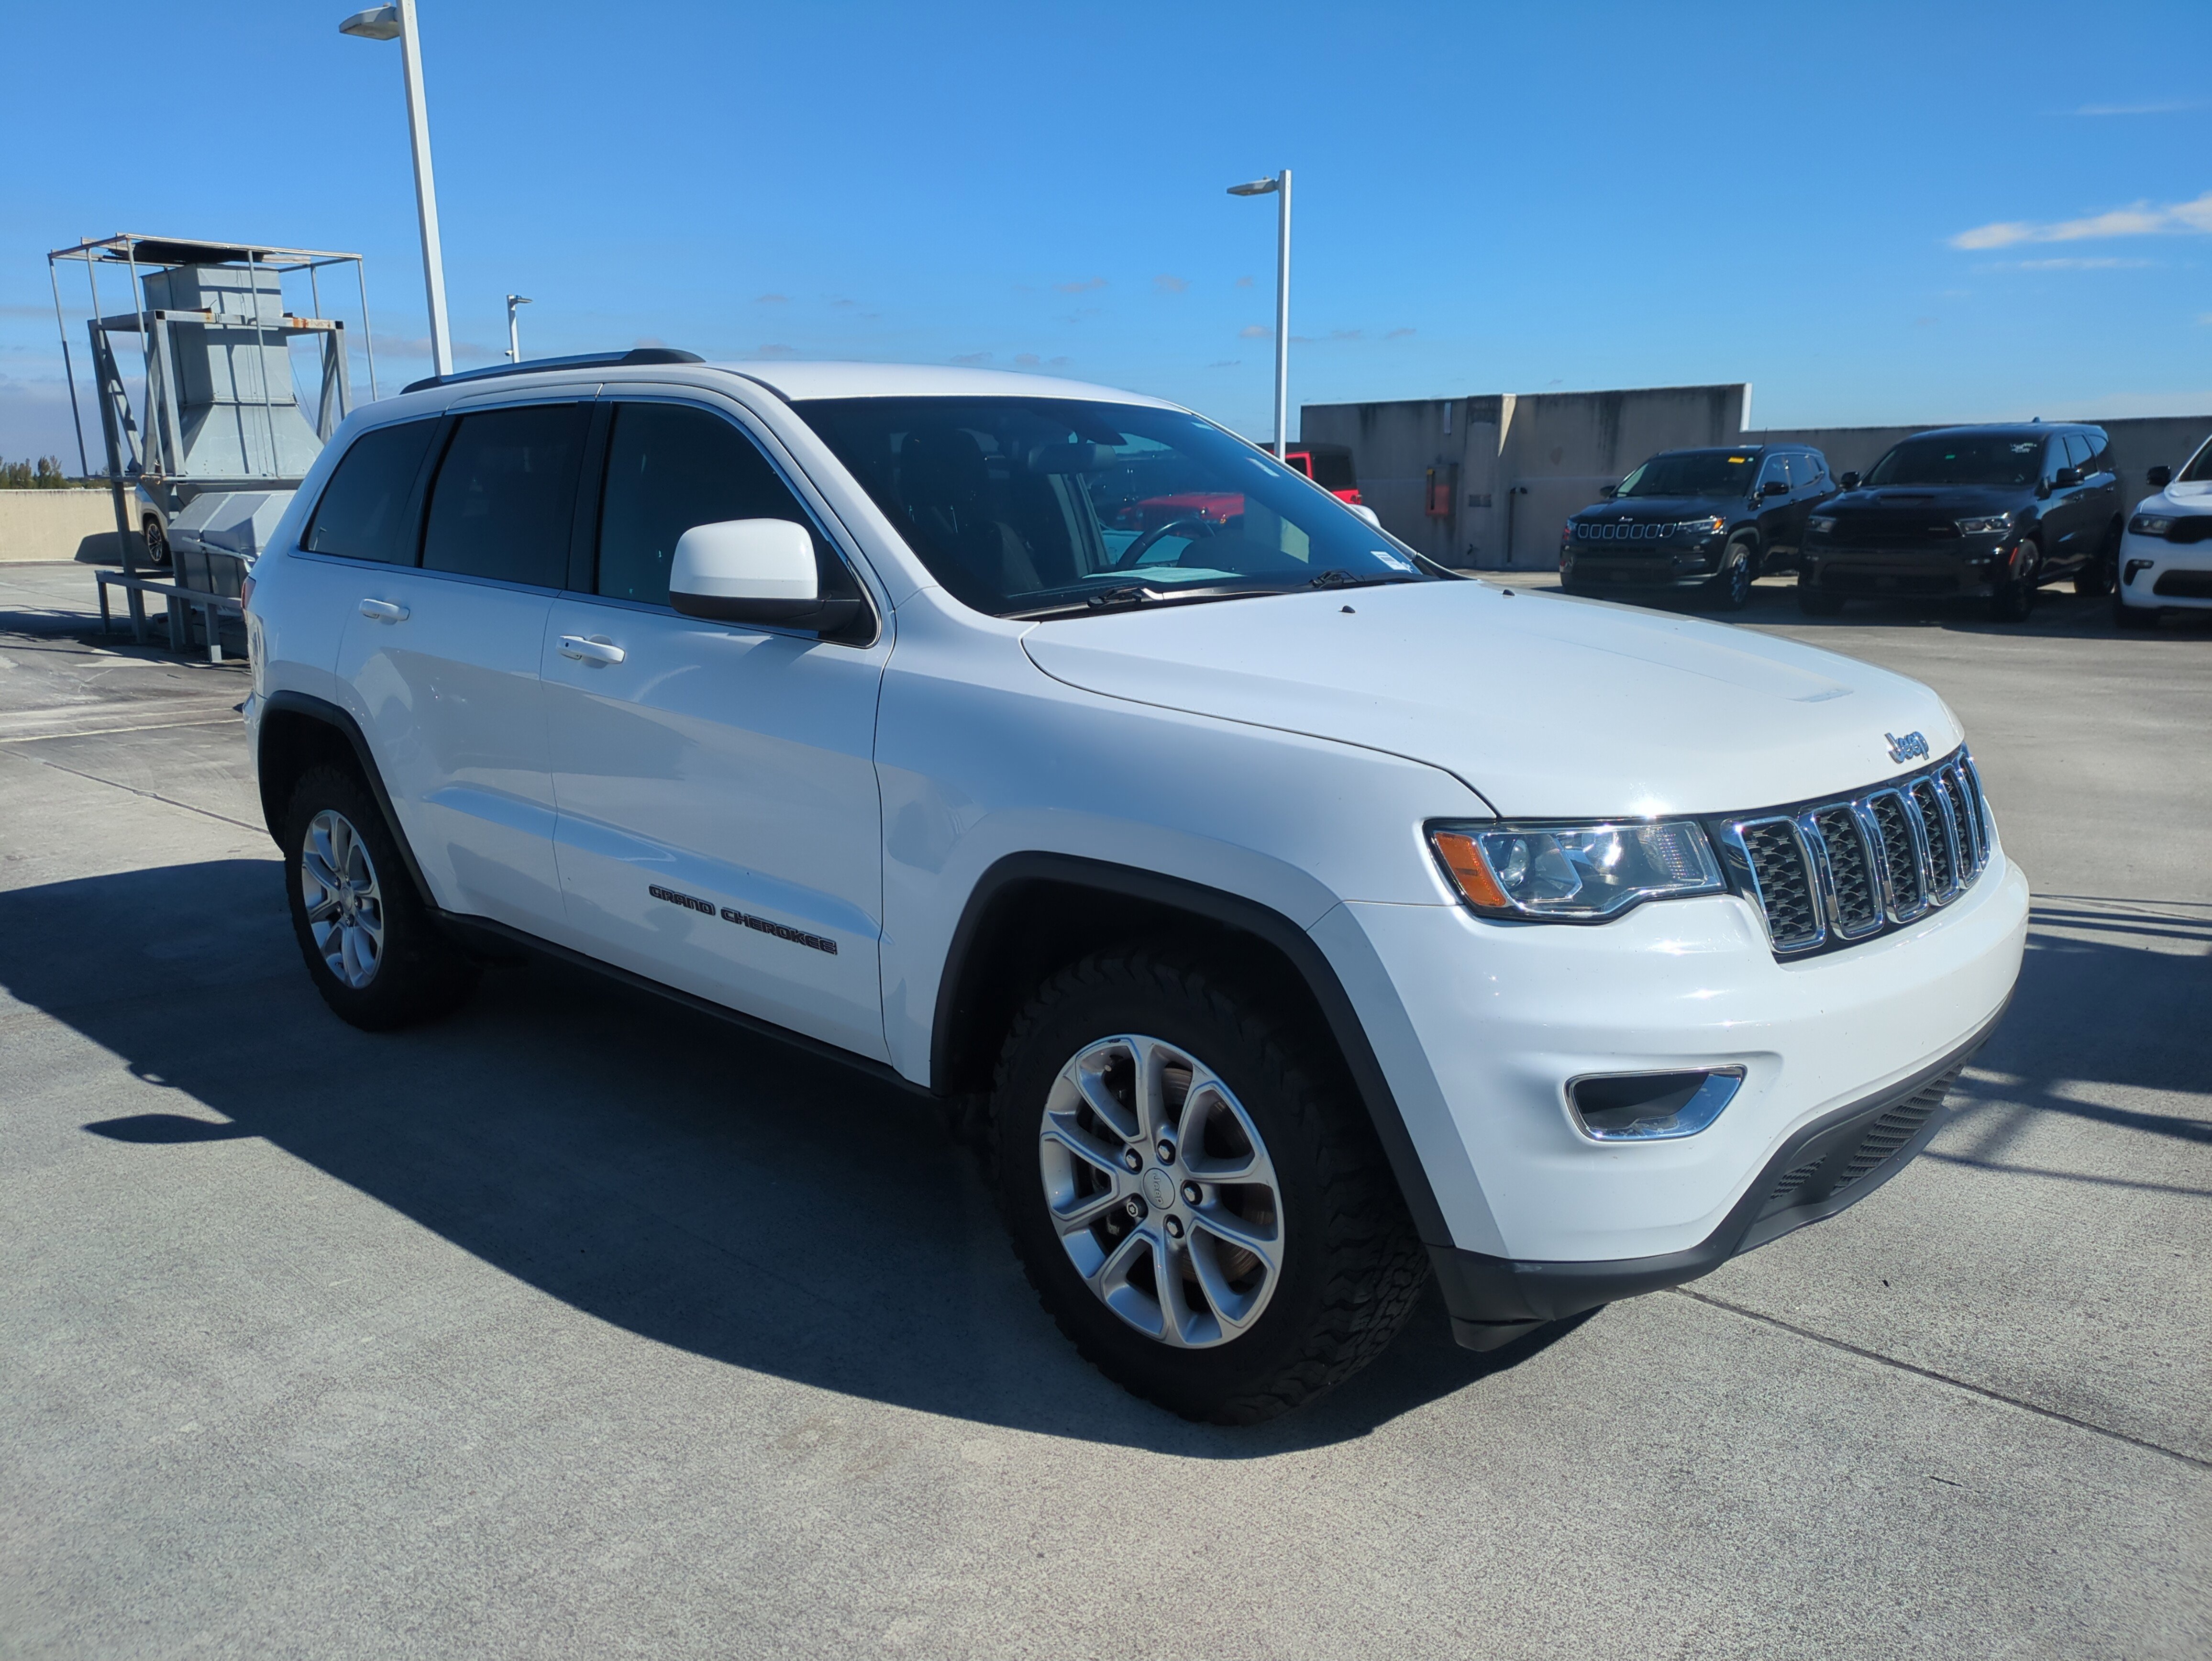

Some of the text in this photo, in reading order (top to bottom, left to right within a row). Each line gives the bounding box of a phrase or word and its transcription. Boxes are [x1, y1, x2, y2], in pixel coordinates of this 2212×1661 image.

[1885, 731, 1929, 764] Jeep
[649, 884, 838, 955] GRAND CHEROKEE
[1152, 1173, 1164, 1205] Jeep
